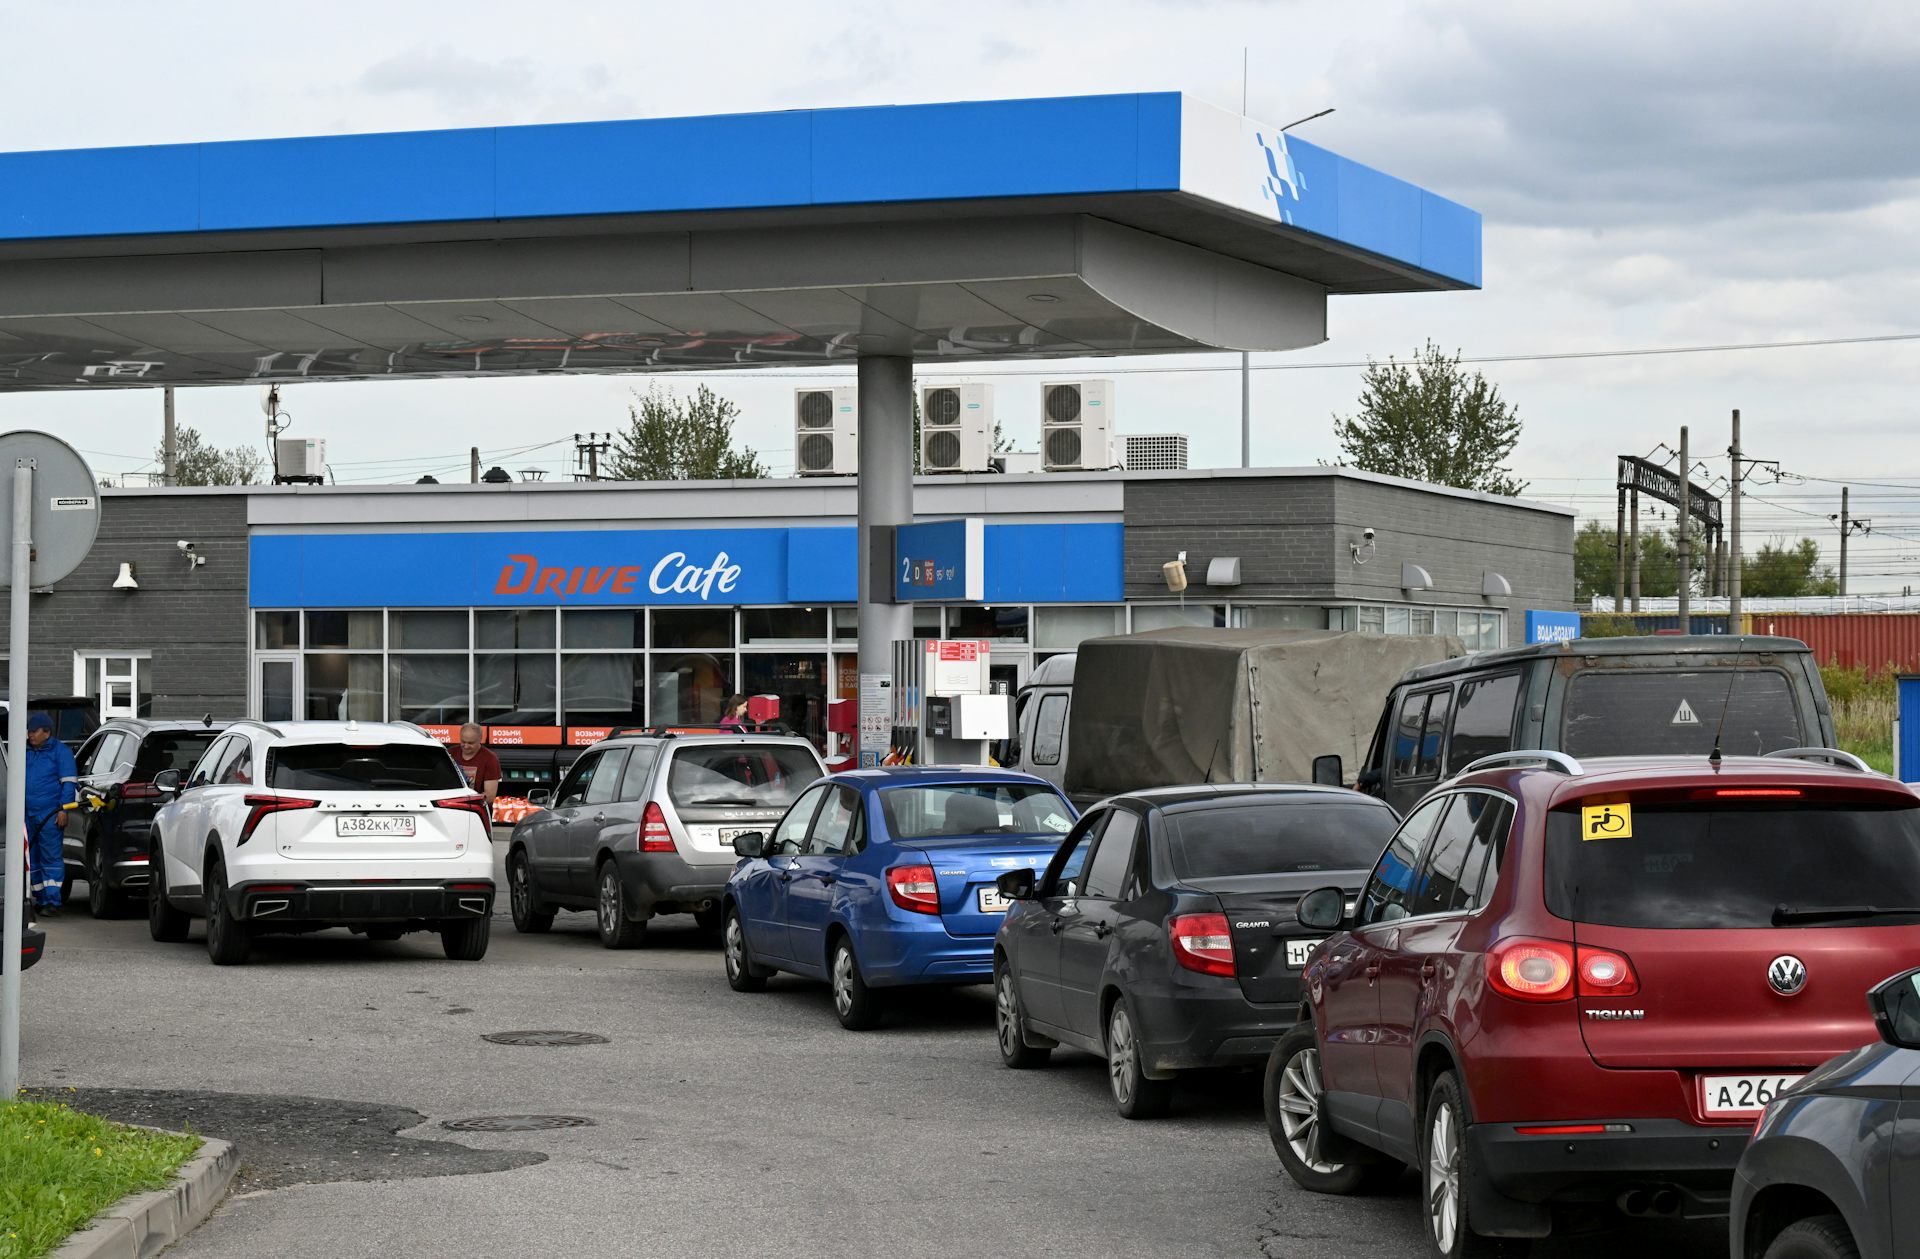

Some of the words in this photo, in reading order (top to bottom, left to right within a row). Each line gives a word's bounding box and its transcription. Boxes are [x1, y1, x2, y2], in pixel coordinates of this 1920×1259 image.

[903, 557, 910, 583] 2
[915, 566, 920, 580] D
[926, 568, 933, 581] 95
[494, 553, 641, 601] DRIVE
[649, 551, 741, 600] Cafe
[1537, 625, 1576, 642] ВОДА-ВОЗДУХ
[982, 643, 987, 651] 1
[492, 729, 521, 737] ВОЗЬМИ
[498, 736, 523, 744] СОБОЙ
[393, 818, 411, 828] 778
[1235, 921, 1270, 929] GRANTA
[1585, 1010, 1645, 1020] TIGUAN
